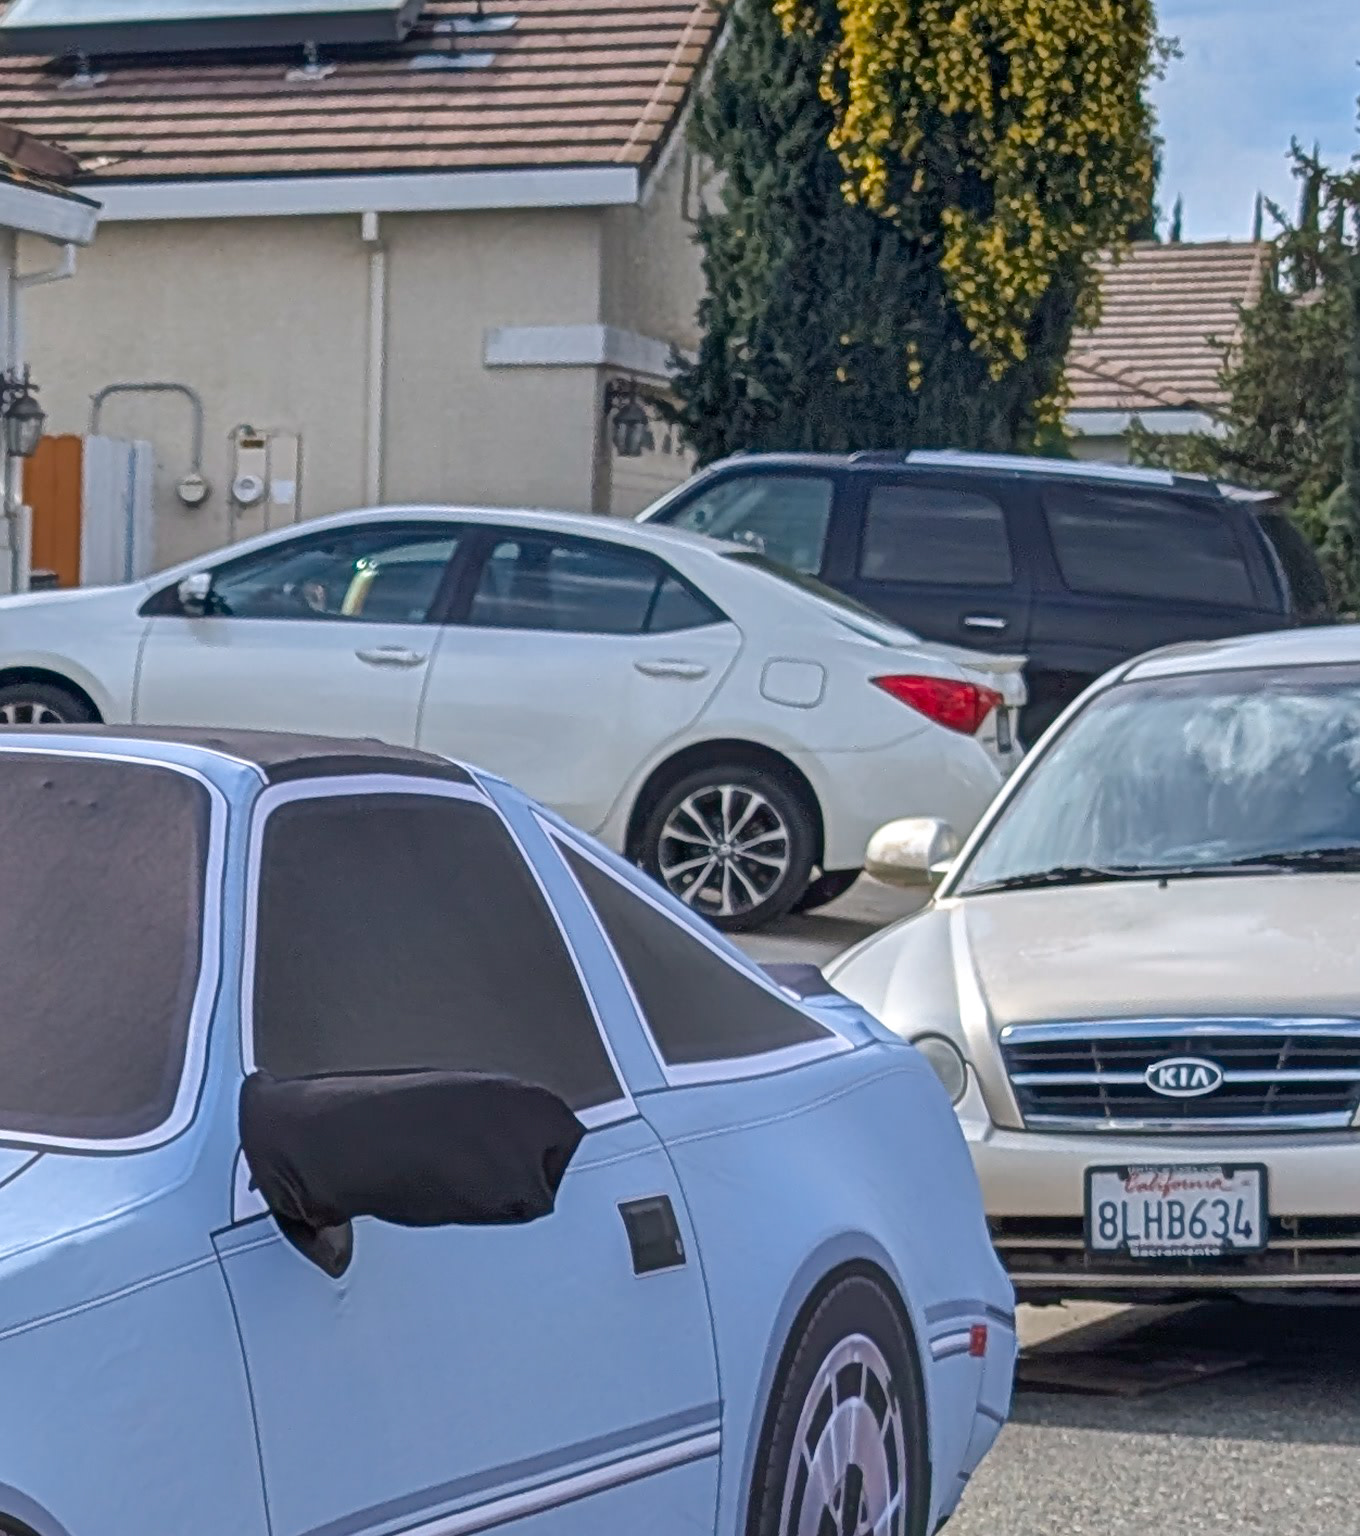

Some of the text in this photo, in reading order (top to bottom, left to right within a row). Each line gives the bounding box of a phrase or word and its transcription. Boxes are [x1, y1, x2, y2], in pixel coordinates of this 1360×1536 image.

[1159, 1067, 1208, 1087] KIA
[1125, 1173, 1232, 1198] California
[1099, 1199, 1252, 1240] 8LHB634
